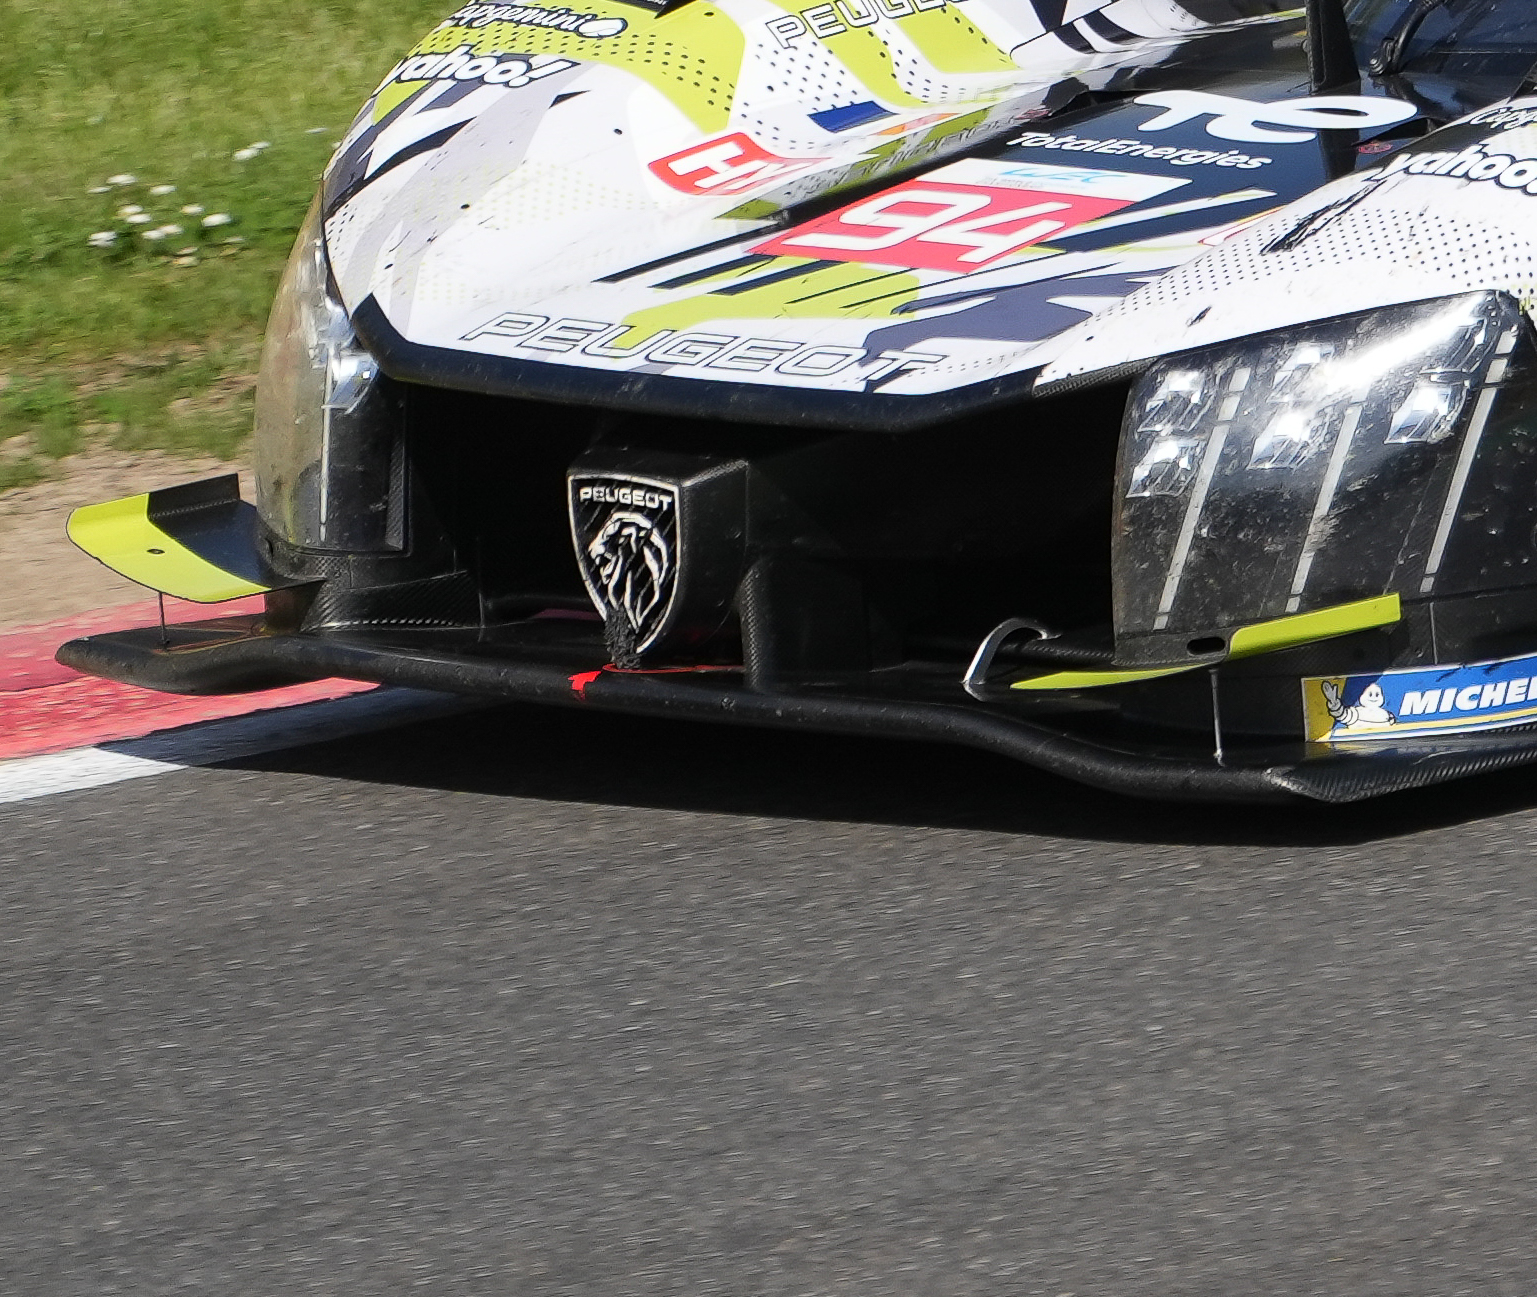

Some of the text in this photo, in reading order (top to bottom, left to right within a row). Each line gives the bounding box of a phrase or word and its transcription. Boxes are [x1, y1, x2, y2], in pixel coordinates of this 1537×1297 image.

[1006, 132, 1273, 170] TotalEnergies
[782, 190, 1073, 264] 94
[459, 311, 949, 382] PEUGEOT
[579, 486, 673, 512] PEUGEOT
